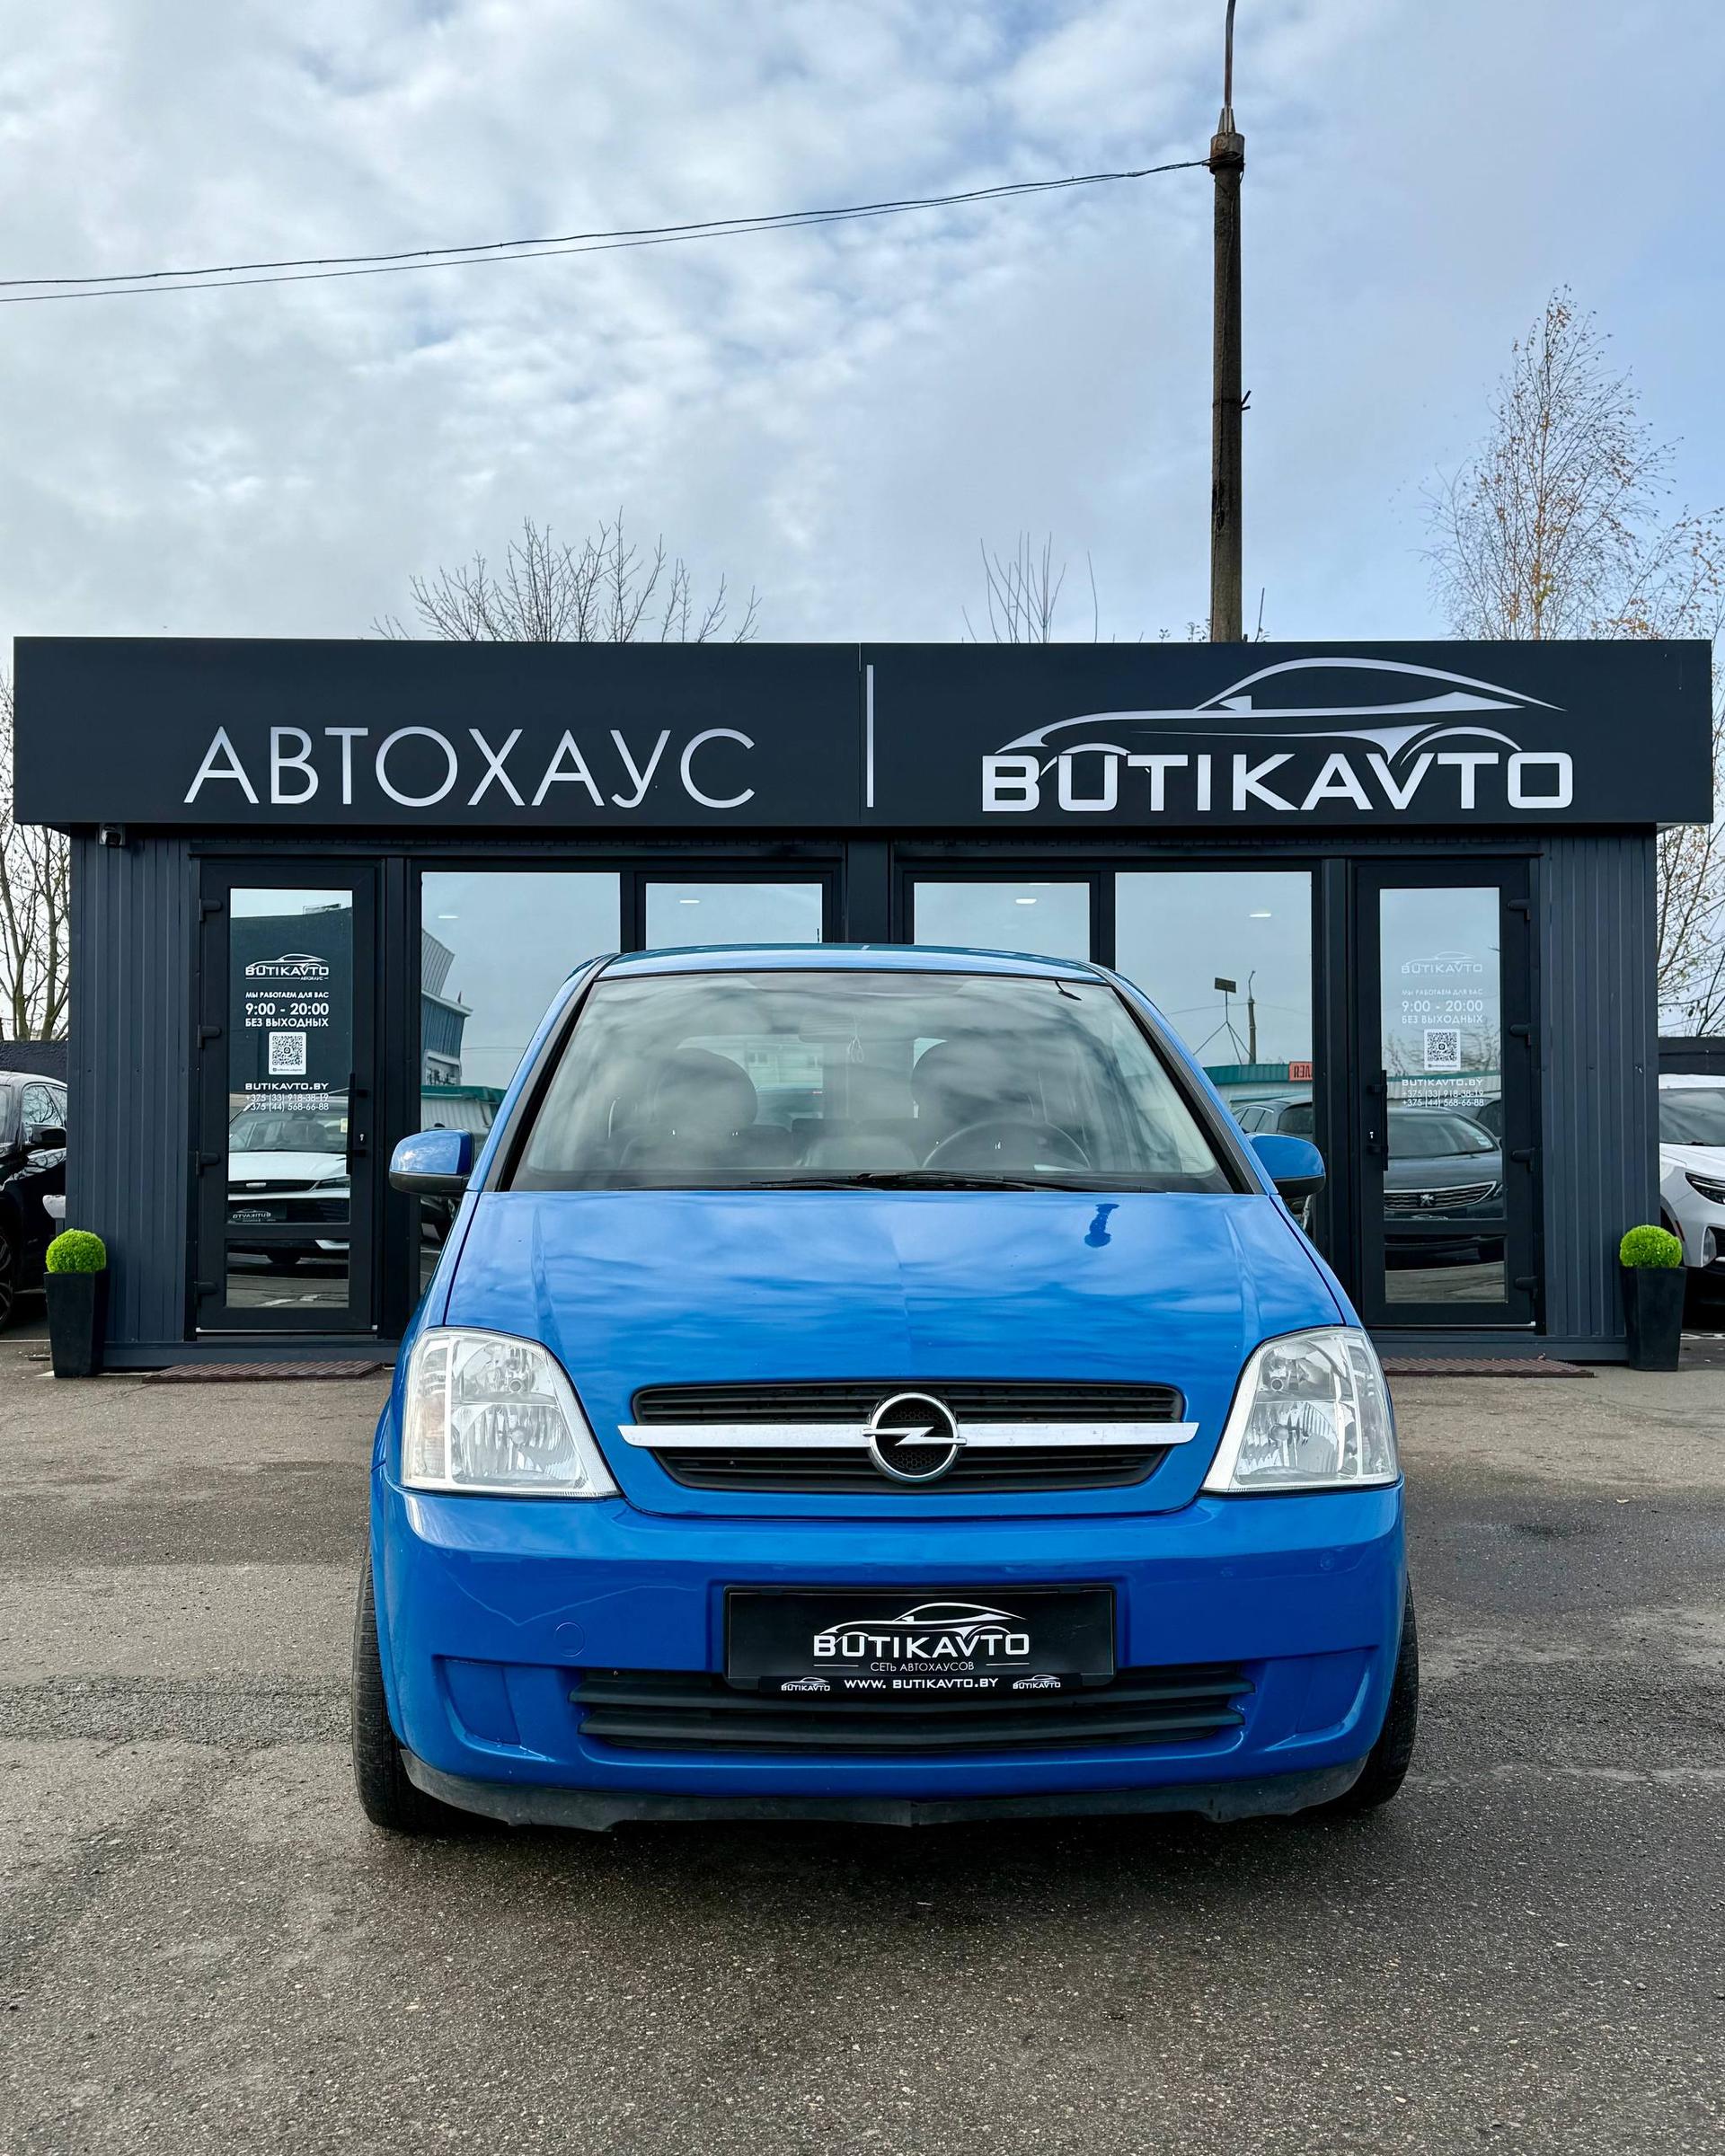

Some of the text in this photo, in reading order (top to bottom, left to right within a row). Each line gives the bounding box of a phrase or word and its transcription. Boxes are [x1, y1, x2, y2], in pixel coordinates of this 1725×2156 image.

[184, 725, 756, 809] АВТОХАУС
[981, 751, 1575, 813] BUTIKAVTO
[245, 966, 329, 976] BUTIKAVTO
[1401, 962, 1482, 974] BUTIKAVTO
[245, 1003, 276, 1015] 9:00
[289, 1003, 330, 1015] 20:00
[1402, 1000, 1431, 1012] 9:00
[1445, 999, 1483, 1012] 20:00
[245, 1018, 329, 1028] БЕЗ ВЫХОДНЫХ
[1402, 1014, 1483, 1025] БЕЗ ВЫХОДНЫХ
[245, 1082, 329, 1091] BUTIKAVTO.BY
[1402, 1090, 1423, 1098] +375
[288, 1102, 330, 1111] 568-66-88
[1402, 1098, 1423, 1107] +375
[813, 1632, 1031, 1659] BUTIKAVTO
[870, 1661, 975, 1673] СЕТЬ АВТОХАУСОВ
[844, 1677, 999, 1689] WWW. BUTIKAVTO.BY
[1012, 1682, 1061, 1690] BUTIKAVTO
